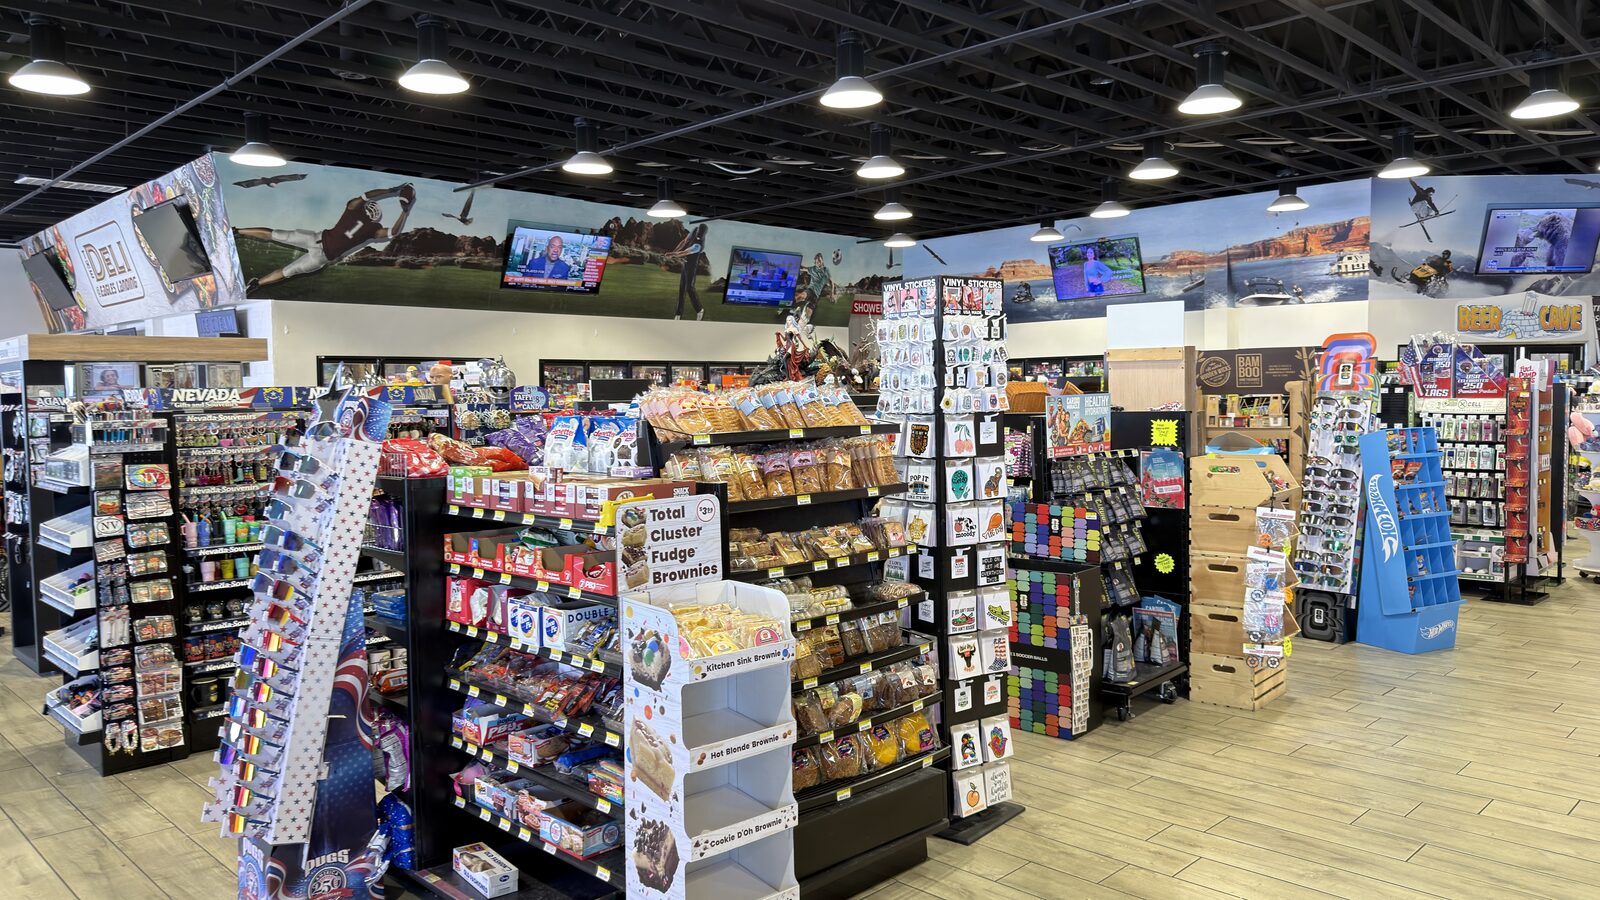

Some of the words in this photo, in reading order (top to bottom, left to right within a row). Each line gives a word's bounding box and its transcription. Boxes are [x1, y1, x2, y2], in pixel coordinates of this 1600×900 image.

[344, 220, 363, 239] 1
[83, 241, 132, 281] DELI
[884, 284, 903, 292] VINYL
[905, 279, 936, 289] STICKERS
[943, 278, 966, 287] VINYL
[968, 280, 1002, 289] STICKERS
[853, 304, 882, 314] SHOWE
[1457, 304, 1502, 332] BEER
[1540, 304, 1583, 332] CAVE
[1238, 356, 1260, 368] BAM
[1238, 367, 1260, 378] BOO
[171, 388, 241, 402] NEVADA
[1084, 395, 1110, 407] HEALTHY
[1425, 389, 1449, 397] LAGS
[218, 413, 257, 421] Souvenirs
[221, 484, 260, 492] Souvenirs
[649, 505, 686, 521] Total
[650, 525, 703, 542] Cluster
[651, 547, 696, 563] Fudge
[652, 562, 718, 585] Brownies
[567, 607, 609, 623] DOUBLE
[706, 660, 735, 672] Kitchen
[736, 655, 752, 666] Sink
[754, 649, 781, 662] Brownie
[710, 750, 724, 760] Hot
[725, 742, 750, 756] Blonde
[751, 734, 779, 748] Brownie
[709, 834, 735, 848] Cookie
[737, 827, 754, 839] D'Oh
[755, 817, 782, 834] Brownie
[304, 848, 350, 878] PUGS
[311, 877, 344, 895] 250
